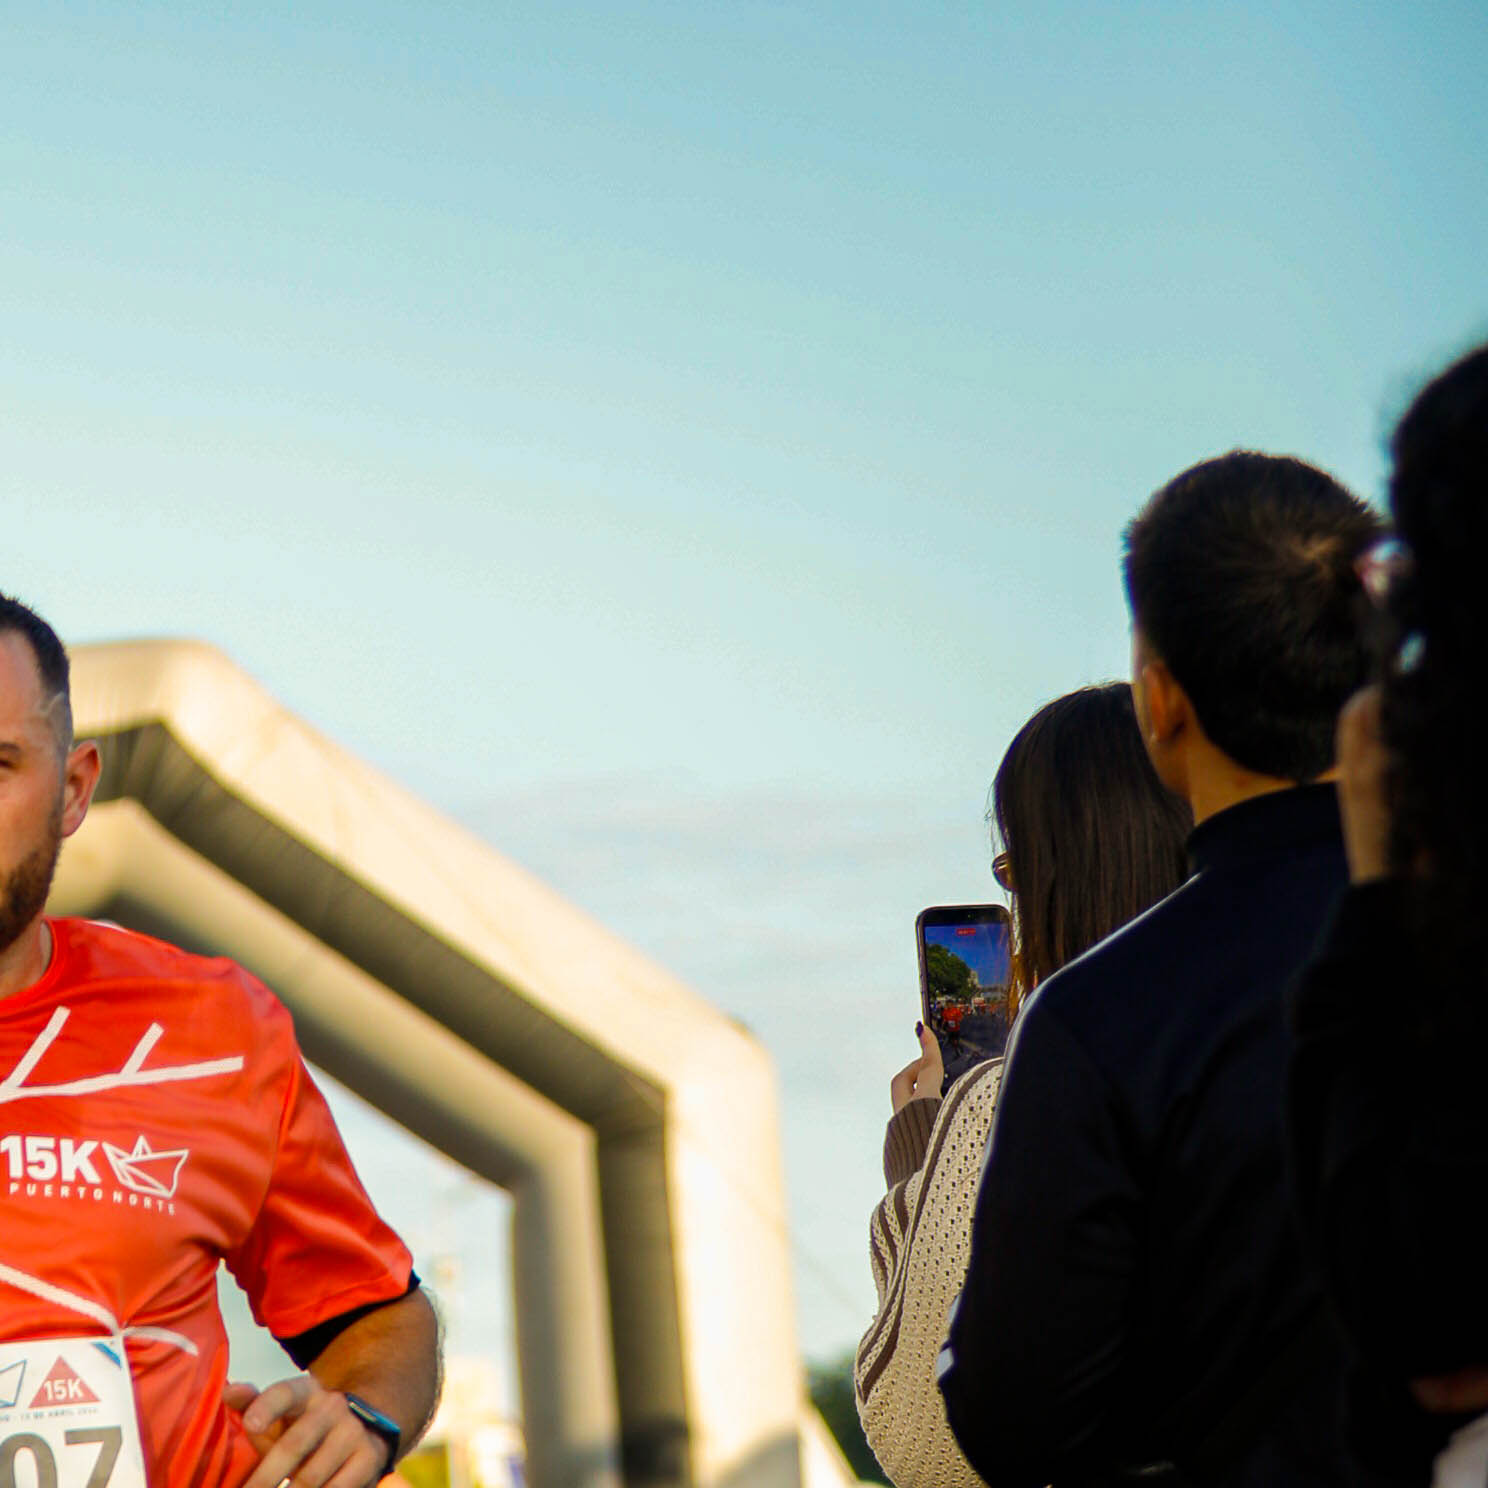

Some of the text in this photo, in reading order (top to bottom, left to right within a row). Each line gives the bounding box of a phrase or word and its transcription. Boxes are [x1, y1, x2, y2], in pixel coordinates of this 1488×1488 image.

[0, 1135, 101, 1184] 15K
[9, 1183, 175, 1215] PUERTO NORTE
[42, 1378, 86, 1402] 15K
